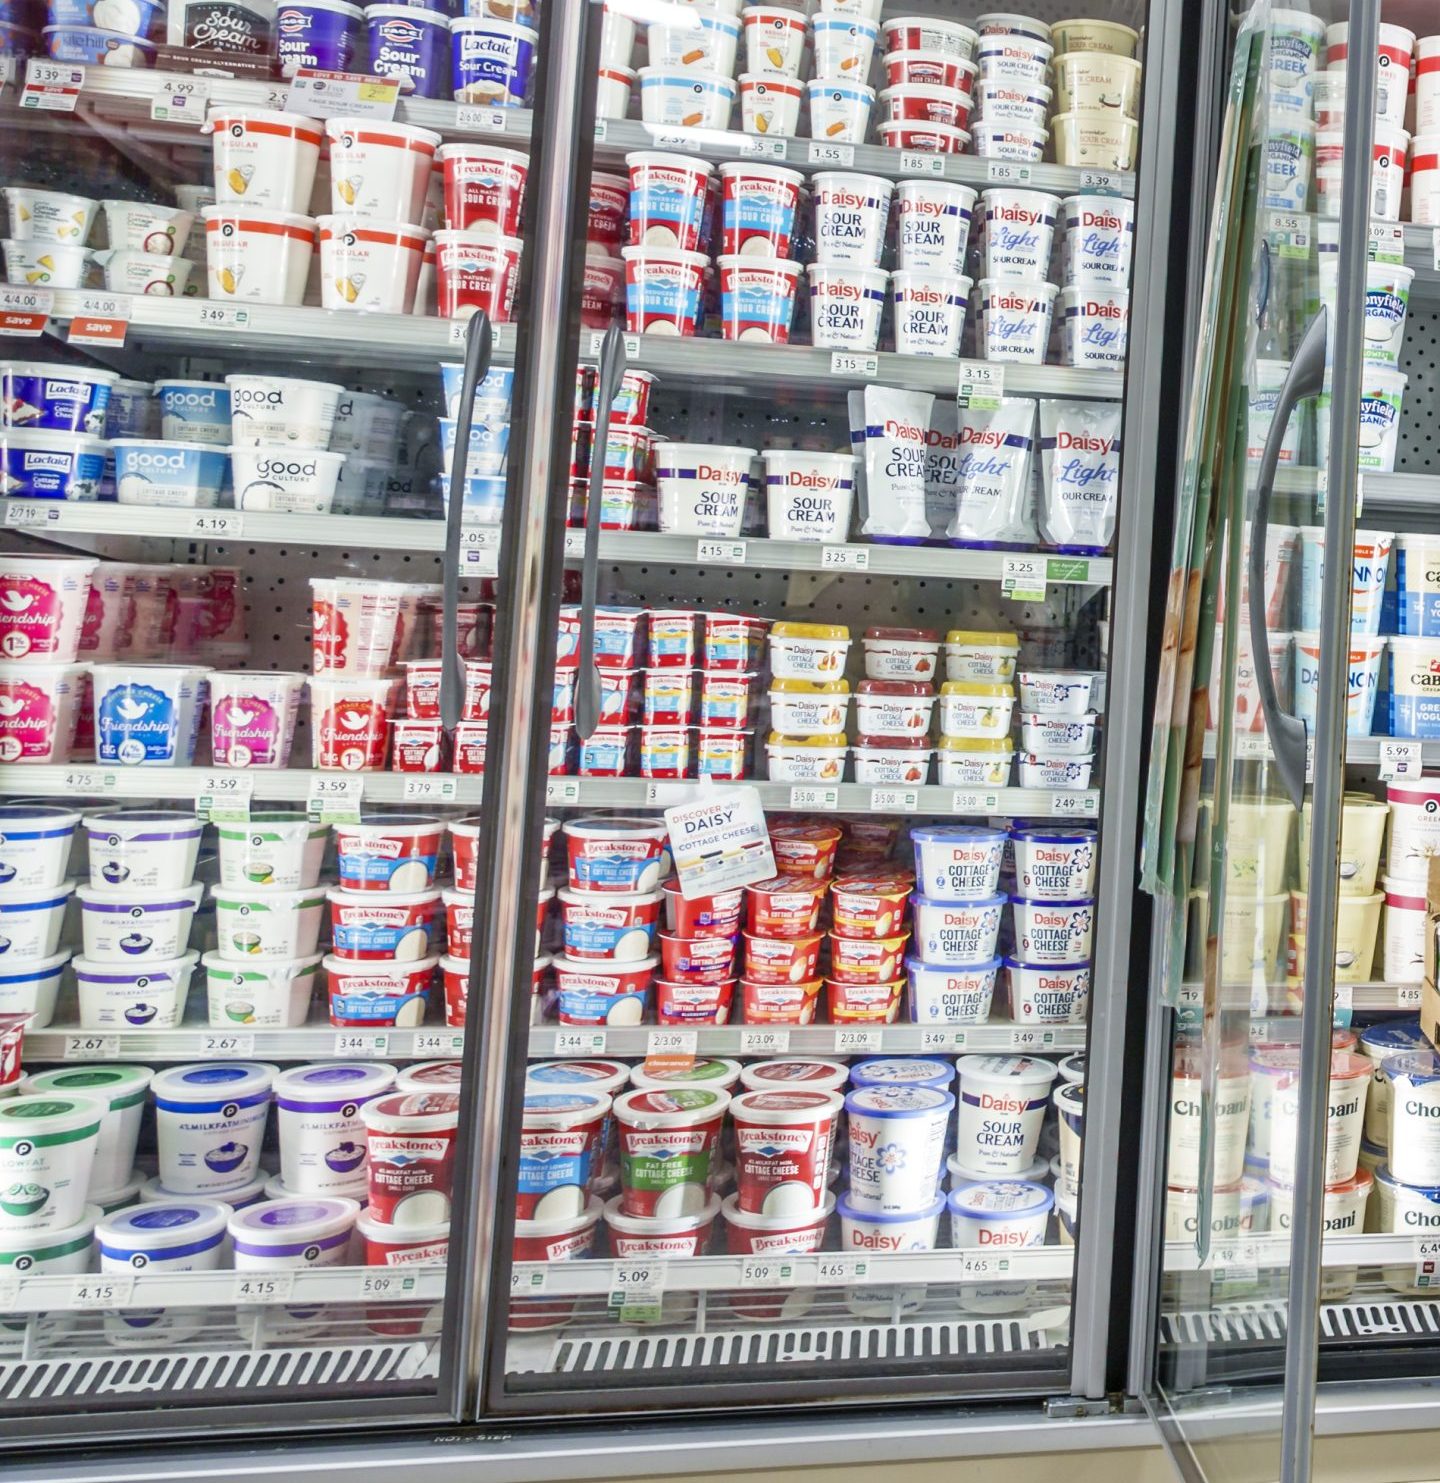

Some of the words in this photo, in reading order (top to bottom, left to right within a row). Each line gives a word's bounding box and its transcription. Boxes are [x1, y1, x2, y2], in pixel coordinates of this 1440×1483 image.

[206, 10, 251, 34] Sour
[381, 47, 421, 63] Sour
[1004, 48, 1033, 61] Daisy
[374, 59, 426, 78] Cream
[459, 60, 486, 71] Sour
[488, 61, 518, 77] Cream
[163, 82, 195, 94] 4.99
[997, 89, 1027, 102] Daisy
[1005, 132, 1033, 147] Daisy
[814, 148, 840, 158] 1.55
[1086, 174, 1109, 186] 3.39
[902, 199, 948, 217] Daisy
[994, 205, 1042, 225] Daisy
[905, 221, 940, 234] SOUR
[902, 232, 945, 246] CREAM
[7, 316, 32, 326] save
[85, 323, 112, 333] save
[965, 368, 990, 379] 3.15
[164, 389, 216, 410] good
[233, 387, 284, 405] good
[960, 427, 1005, 448] Daisy
[1058, 432, 1114, 453] Daisy
[26, 453, 69, 467] Lactaid
[126, 451, 186, 471] good
[256, 459, 317, 480] good
[1058, 460, 1116, 485] Light
[701, 492, 737, 504] SOUR
[793, 497, 831, 510] SOUR
[694, 503, 738, 517] CREAM
[196, 518, 227, 529] 4.19
[1008, 562, 1033, 573] 3.25
[793, 645, 814, 656] Daisy
[892, 648, 912, 659] Daisy
[101, 718, 170, 734] Friendship
[1047, 720, 1069, 731] Daisy
[1386, 746, 1408, 757] 5.99
[207, 778, 236, 789] 3.59
[317, 780, 347, 792] 3.59
[672, 805, 720, 823] DISCOVER
[685, 811, 733, 833] DAISY
[679, 835, 719, 850] COTTAGE
[954, 849, 986, 864] Daisy
[1036, 849, 1070, 864] Daisy
[948, 864, 988, 876] COTTAGE
[1032, 865, 1073, 876] COTTAGE
[952, 876, 985, 887] CHEESE
[1036, 876, 1070, 888] CHEESE
[1035, 912, 1069, 928] Daisy
[1031, 929, 1071, 940] COTTAGE
[1034, 939, 1069, 951] CHEESE
[1039, 976, 1073, 992] Daisy
[1034, 992, 1075, 1003] COTTAGE
[1038, 1003, 1072, 1015] CHEESE
[72, 1038, 102, 1049] 2.67
[207, 1038, 236, 1049] 2.67
[654, 1035, 682, 1046] 2/3.09
[747, 1033, 774, 1045] 2/3.09
[841, 1032, 867, 1043] 2/3.09
[981, 1093, 1031, 1113] Daisy
[982, 1120, 1022, 1134] SOUR
[627, 1133, 703, 1146] Breakstone's
[739, 1131, 807, 1143] Breakstone's
[976, 1132, 1025, 1147] CREAM
[635, 1168, 664, 1178] COTTAGE
[665, 1167, 693, 1176] CHEESE
[744, 1165, 772, 1175] COTTAGE
[773, 1165, 799, 1175] CHEESE
[852, 1228, 902, 1249] Daisy
[978, 1228, 1028, 1247] Daisy
[618, 1271, 649, 1283] 5.09
[78, 1287, 113, 1298] 4.15
[241, 1282, 274, 1294] 4.15
